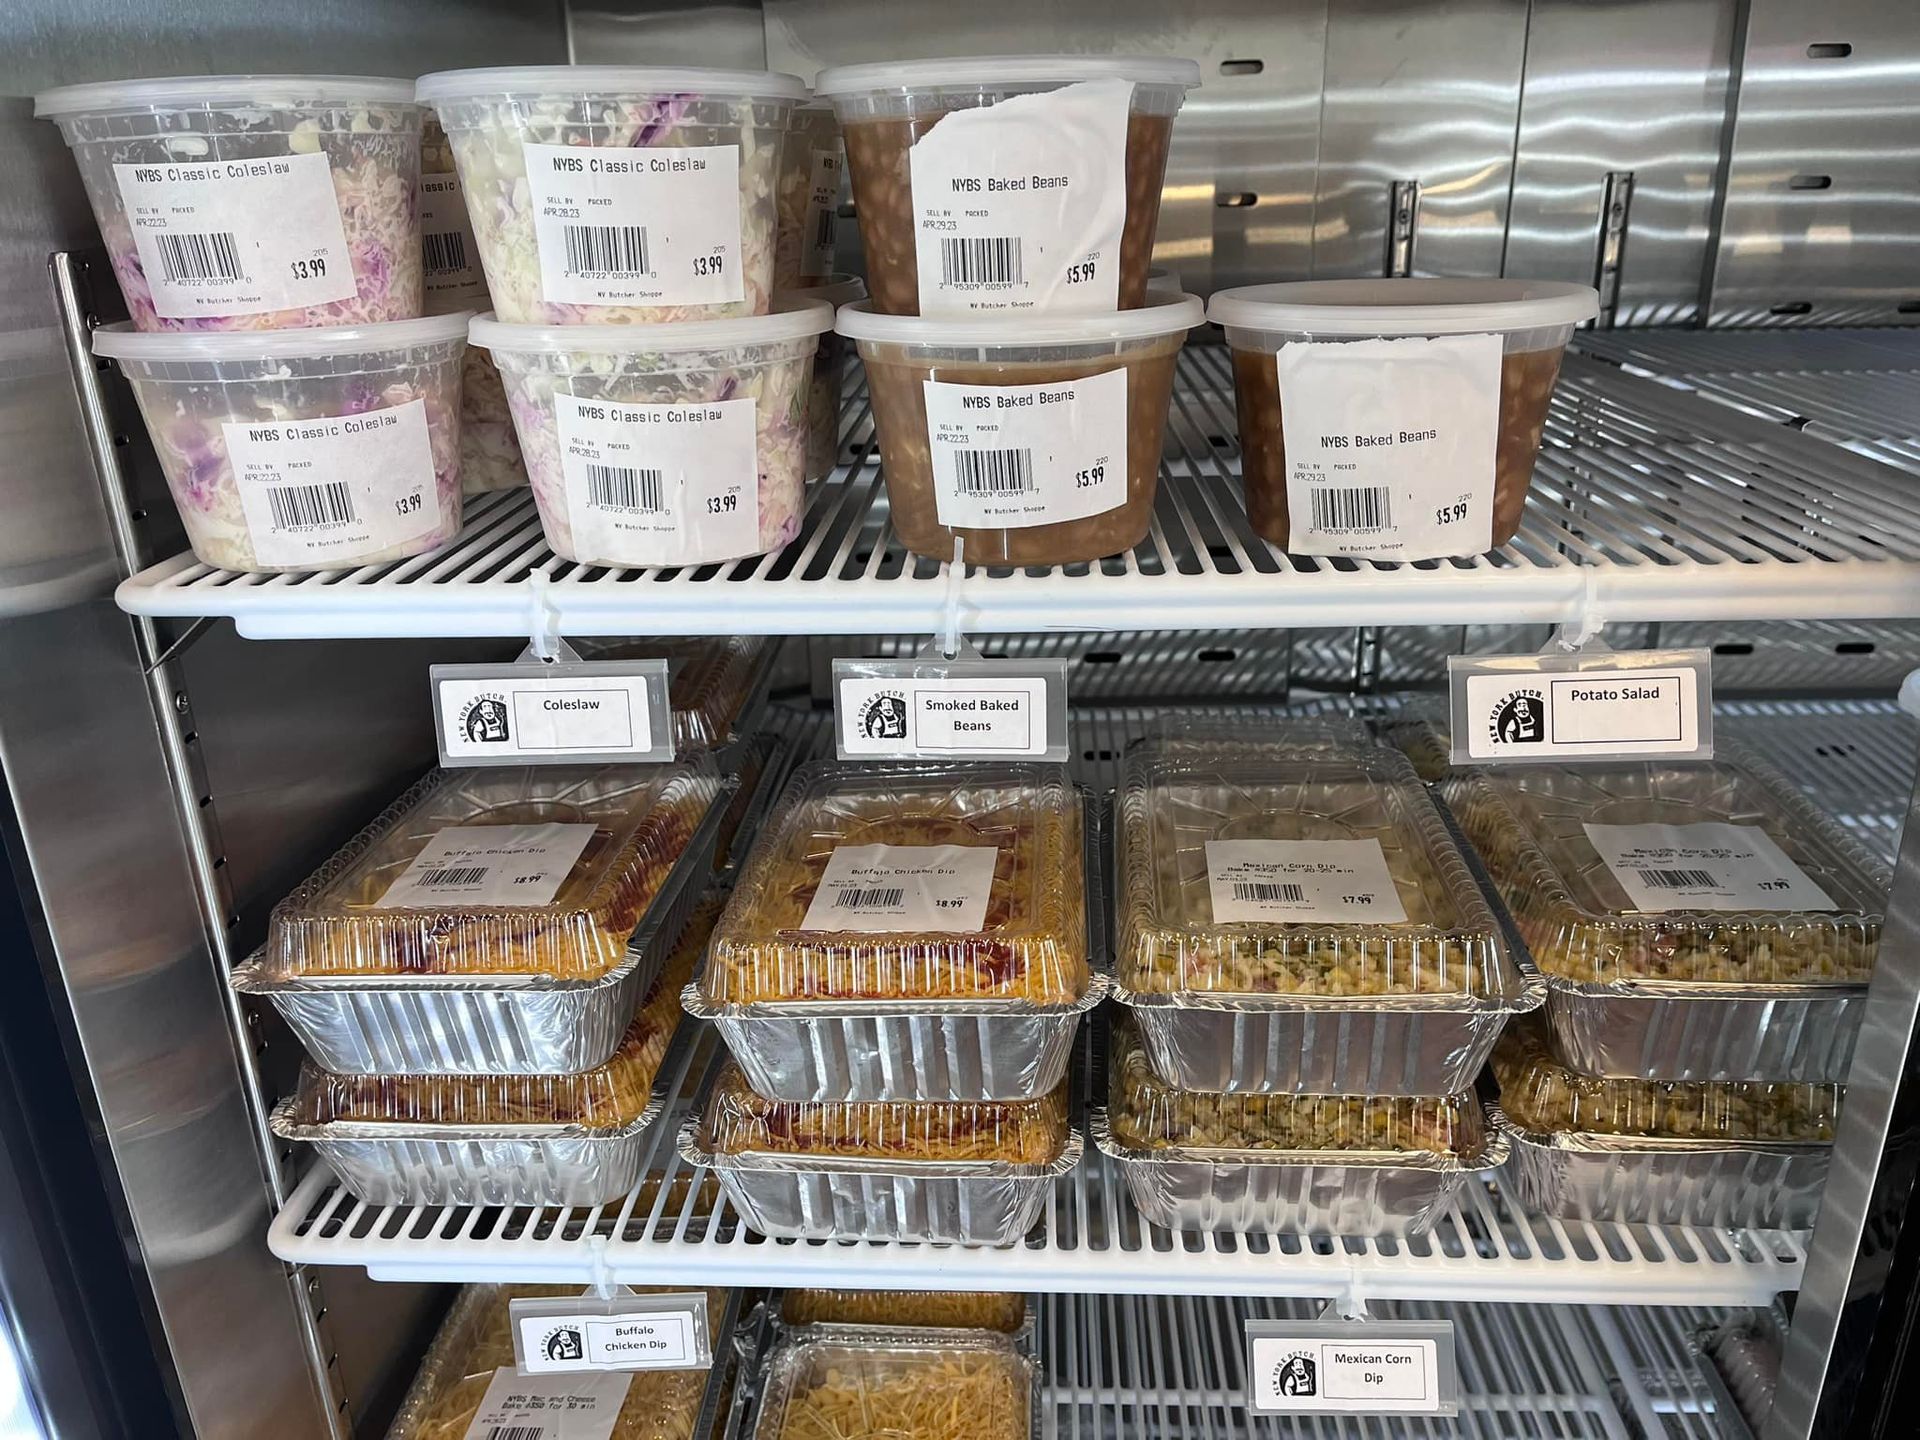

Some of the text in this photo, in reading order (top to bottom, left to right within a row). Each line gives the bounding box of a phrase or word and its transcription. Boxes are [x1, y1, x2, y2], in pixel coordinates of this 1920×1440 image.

[135, 161, 290, 183] NYBS Classic Coleslaw
[553, 158, 706, 173] NYBS Classic Coleslaw
[952, 176, 1069, 192] NYBS Baked Beans
[1088, 252, 1100, 261] 220
[291, 259, 326, 280] $3.99
[693, 256, 723, 276] $3.99
[1067, 262, 1095, 284] $5.99
[962, 390, 1075, 409] NYBS Baked Beans
[578, 406, 722, 423] NYBS Classic Coleslaw
[250, 415, 398, 442] NYBS Classic Coleslaw
[1321, 429, 1437, 448] NYBS Baked Beans
[1096, 456, 1109, 466] 220
[1076, 466, 1104, 488] $5.99
[395, 494, 422, 516] $3.99
[707, 495, 736, 514] $3.99
[1458, 493, 1472, 502] 220
[1436, 503, 1467, 526] $5.99
[1572, 687, 1660, 702] Potato Salad
[459, 701, 474, 721] YORK
[544, 700, 600, 711] Coleslaw
[858, 697, 873, 717] YORK
[926, 700, 1019, 711] Smoked Baked
[1490, 698, 1508, 720] YORK
[954, 720, 991, 731] Beans
[514, 875, 542, 884] $8.99
[852, 868, 890, 876] Buffalo
[936, 900, 963, 908] $8.99
[1342, 896, 1371, 905] $7.99
[616, 1326, 654, 1336] Buffalo
[605, 1340, 667, 1351] Chicken Dip
[1273, 1358, 1287, 1376] YORK
[1335, 1354, 1412, 1364] Mexican Corn
[1364, 1373, 1384, 1383] Dip
